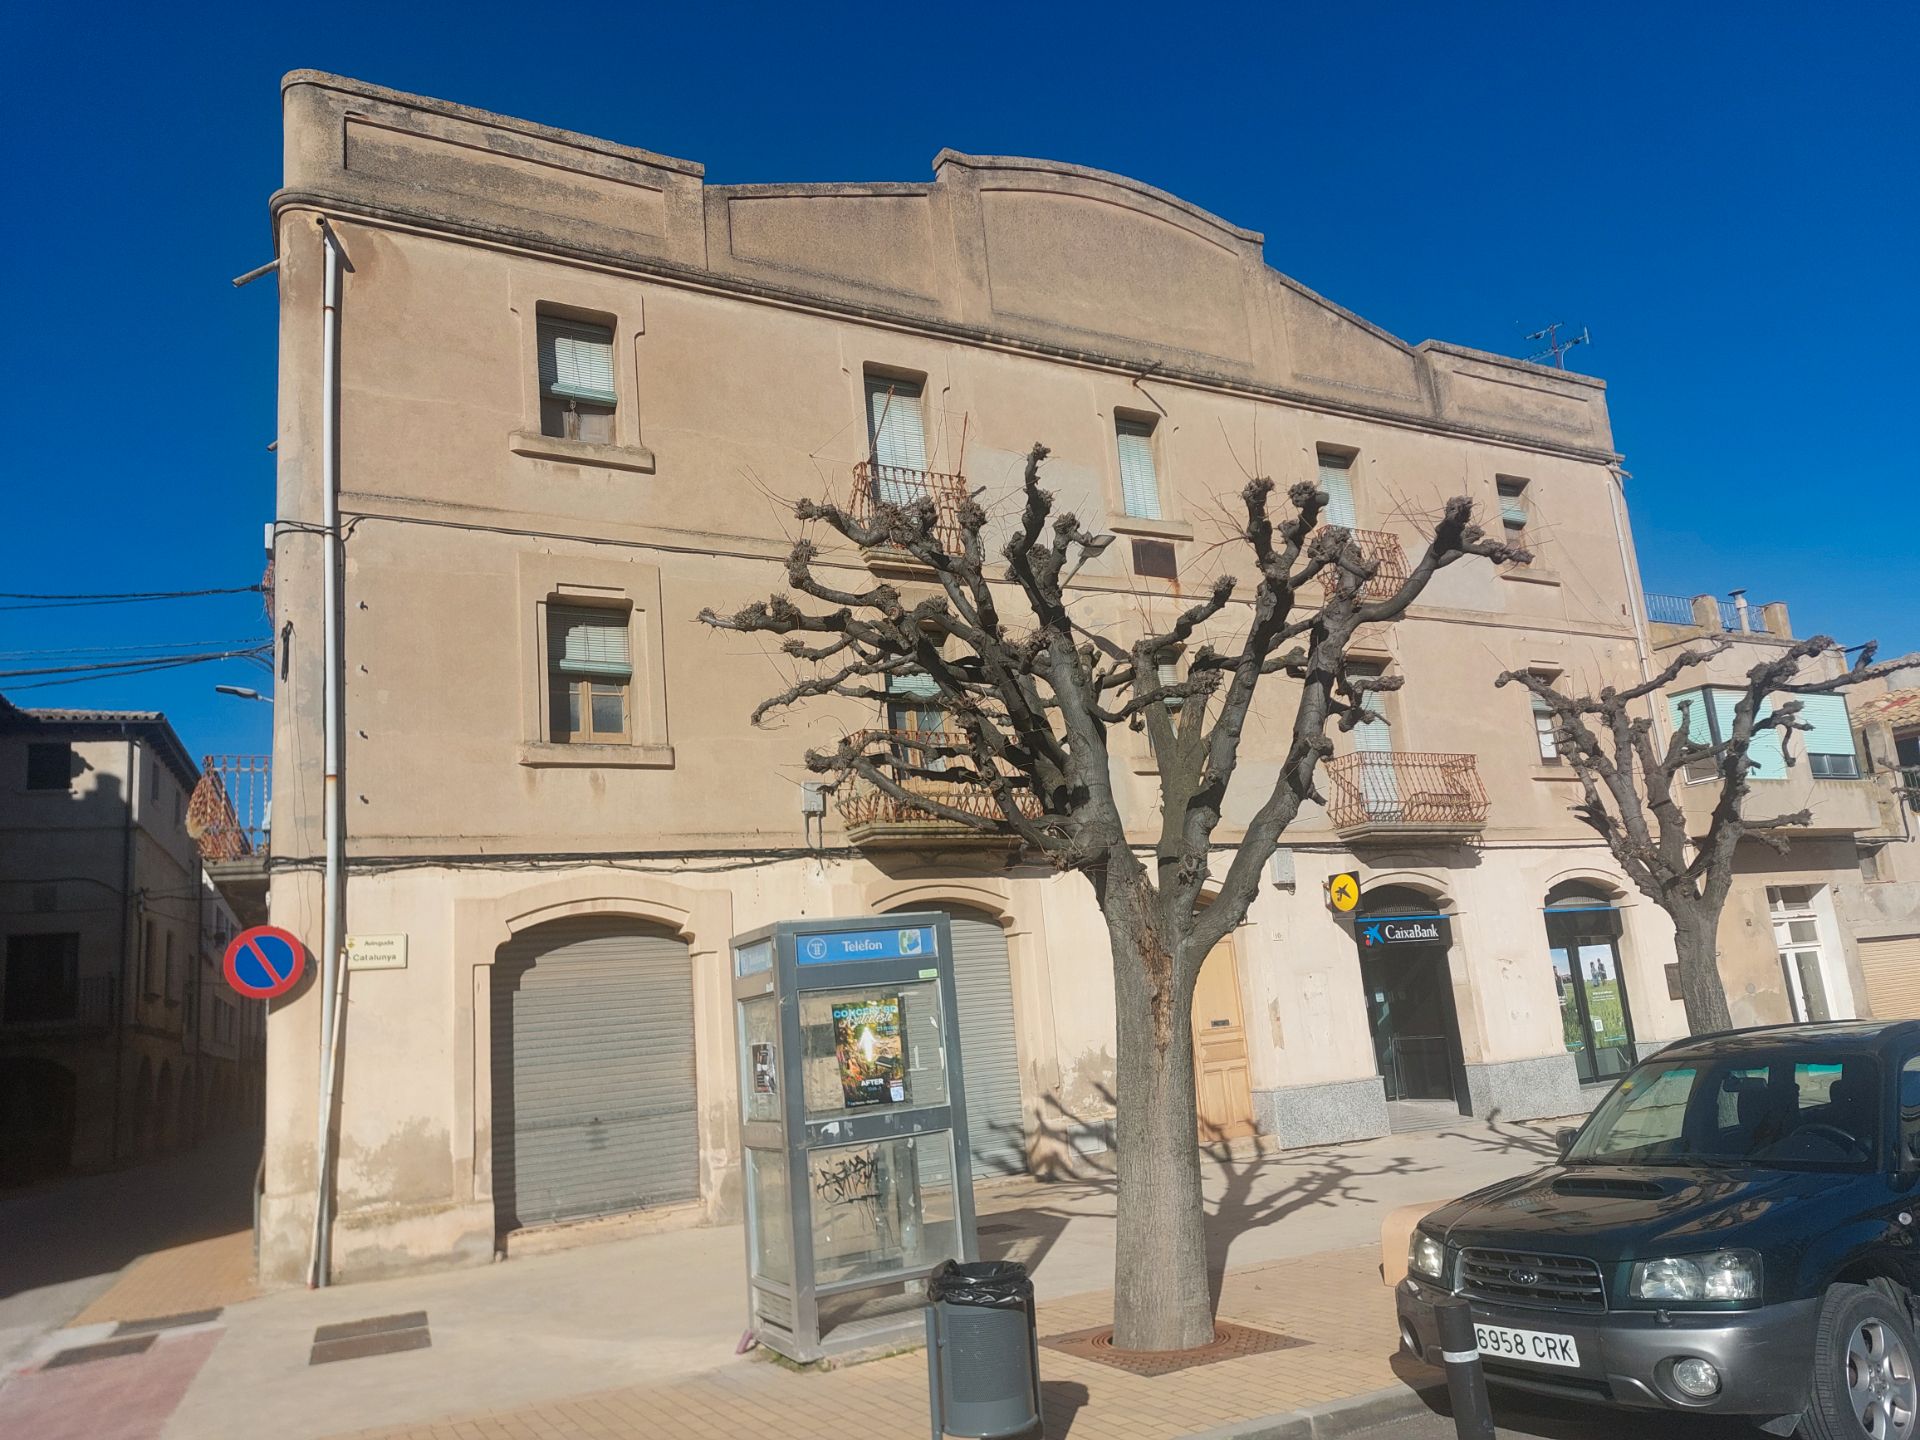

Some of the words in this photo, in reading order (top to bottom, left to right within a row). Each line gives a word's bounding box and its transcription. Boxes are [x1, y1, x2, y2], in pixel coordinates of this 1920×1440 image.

[1385, 923, 1439, 939] CaixaBank
[841, 939, 883, 953] Telèfon
[861, 1078, 884, 1087] AFTER
[1476, 1328, 1526, 1355] 6958
[1532, 1335, 1575, 1362] CRK
